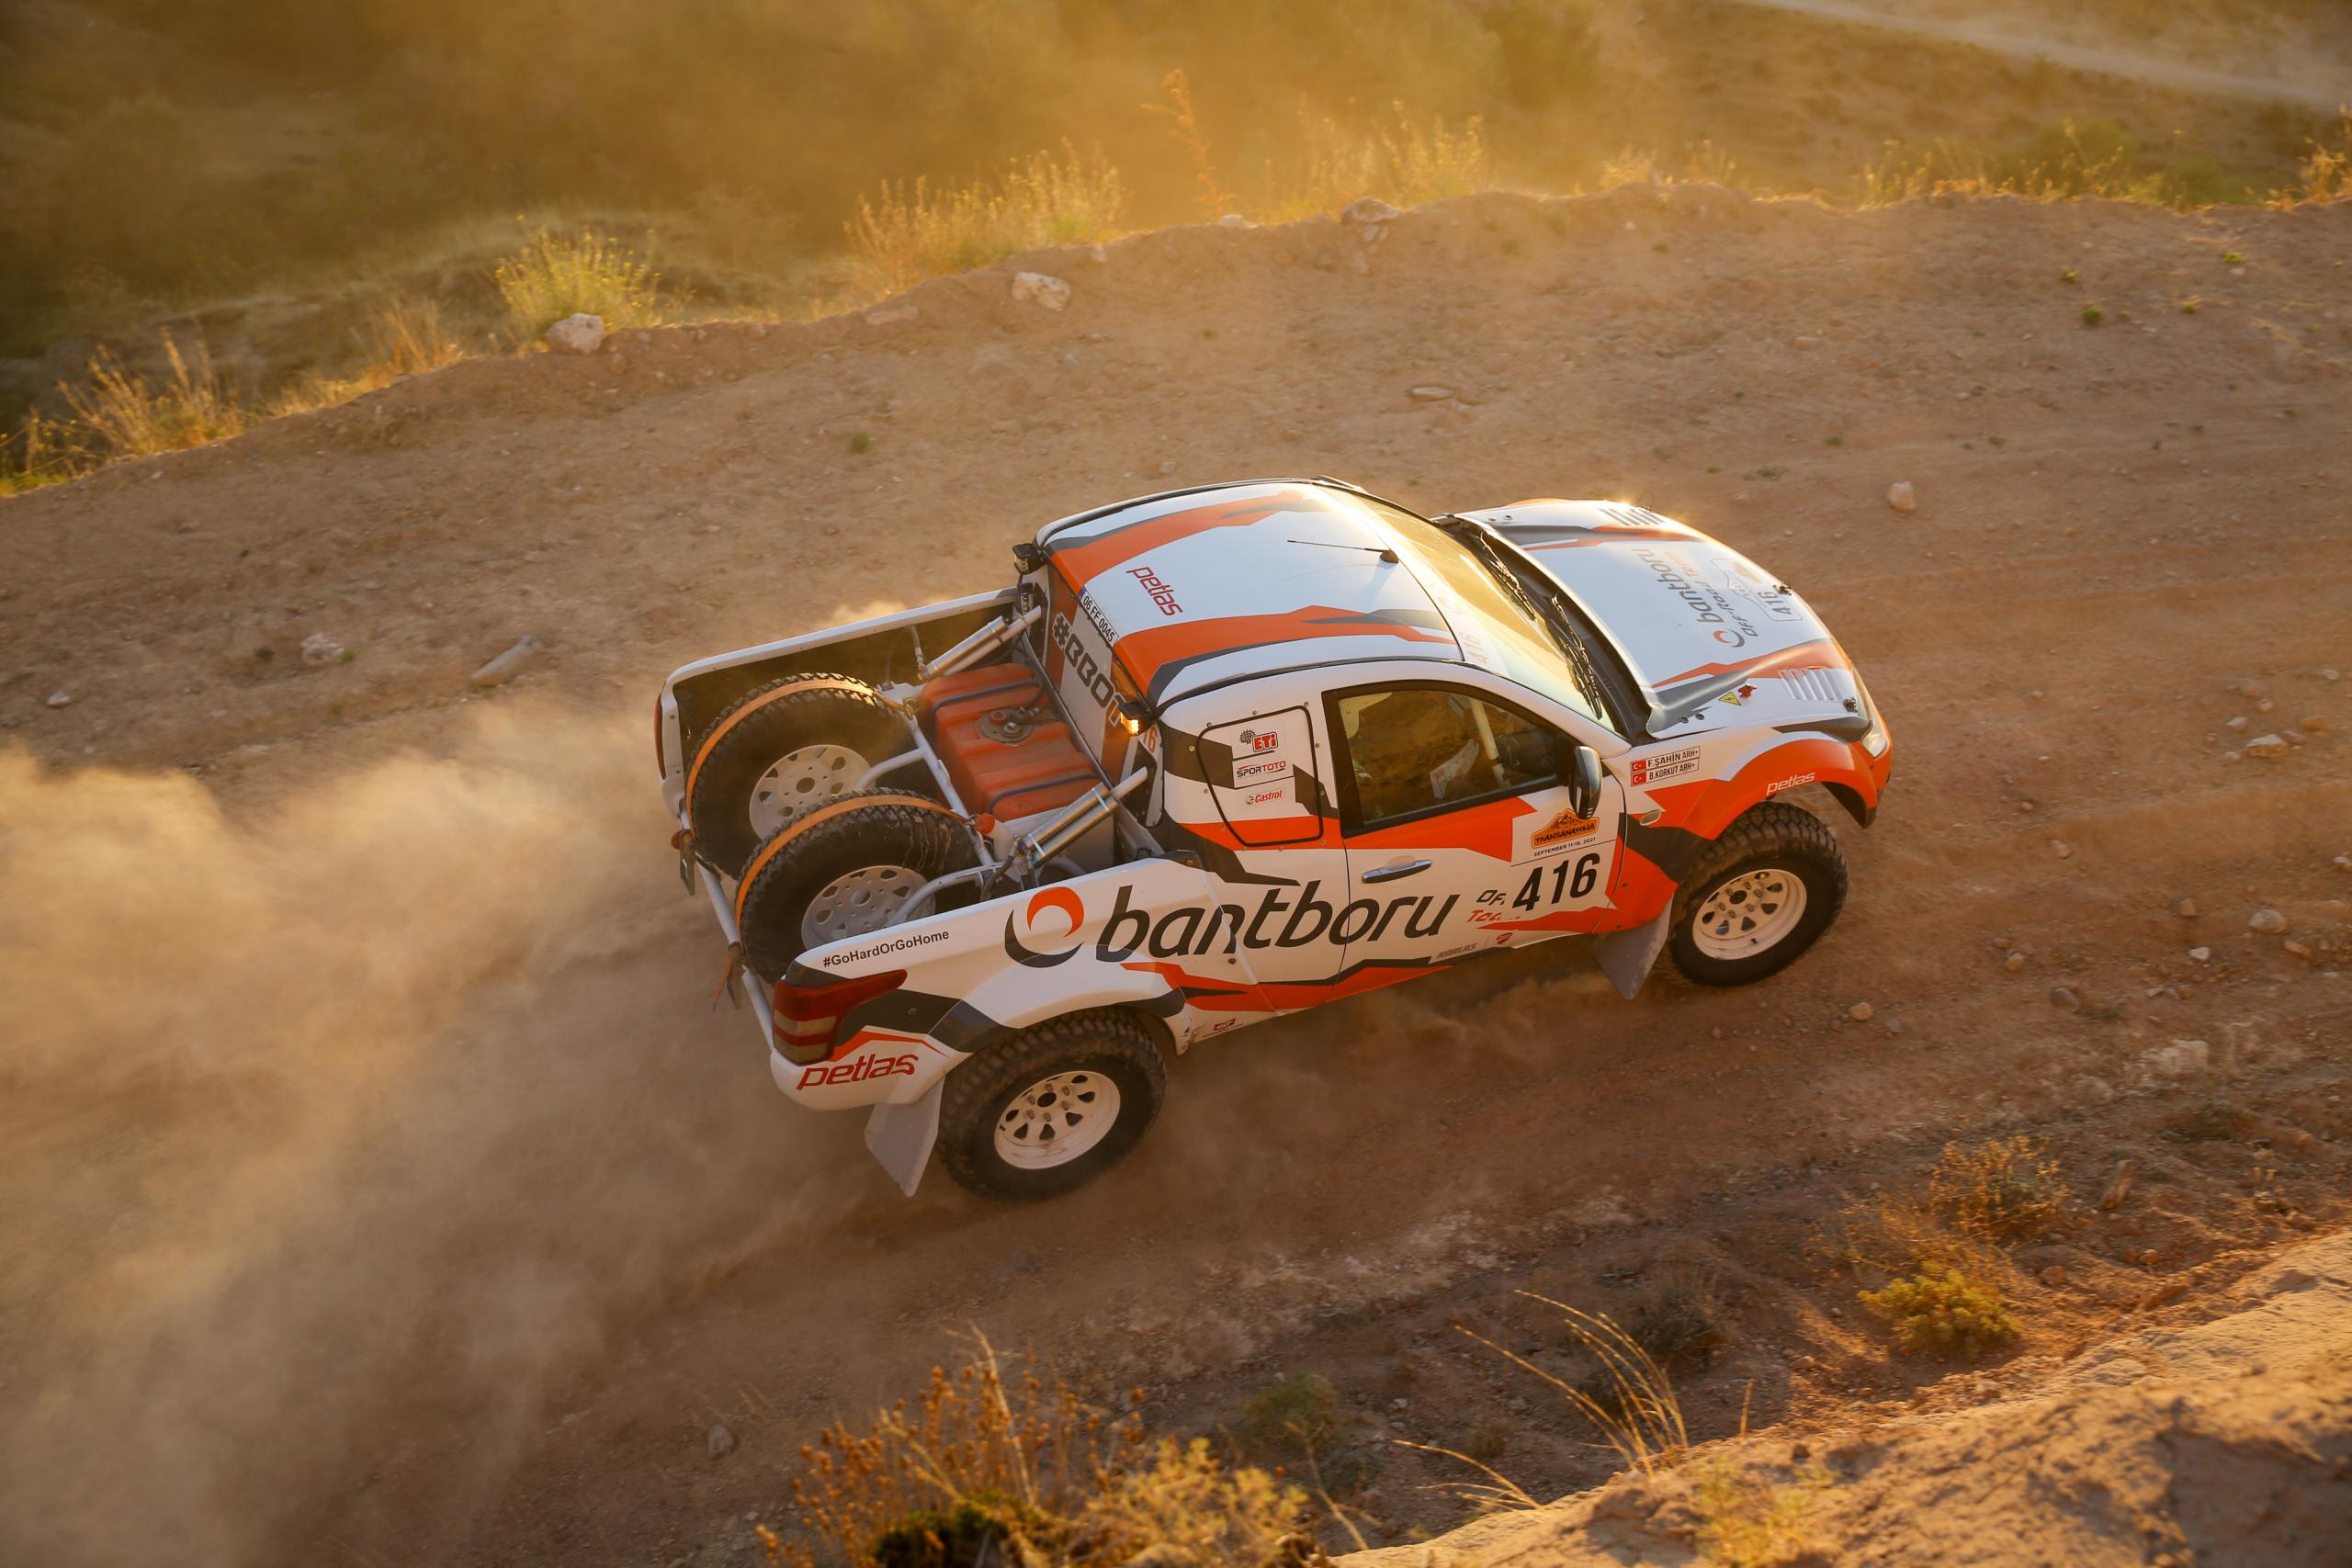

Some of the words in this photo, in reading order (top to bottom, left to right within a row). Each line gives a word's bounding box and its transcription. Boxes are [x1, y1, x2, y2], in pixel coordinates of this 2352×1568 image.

[1125, 566, 1183, 616] petlas
[1631, 548, 1724, 623] bantboru
[1758, 591, 1792, 615] 416
[1082, 595, 1093, 611] 06
[1090, 605, 1102, 620] FF
[1098, 617, 1115, 642] 0045
[1254, 789, 1283, 804] Castrol
[1766, 772, 1816, 796] petlas
[1533, 843, 1567, 857] SEPTEMBER
[1583, 837, 1596, 845] 2021
[1512, 852, 1600, 913] 416
[1095, 879, 1462, 963] bantboru
[822, 931, 950, 968] #GoHardOrGoHome
[796, 1053, 920, 1091] petlas
